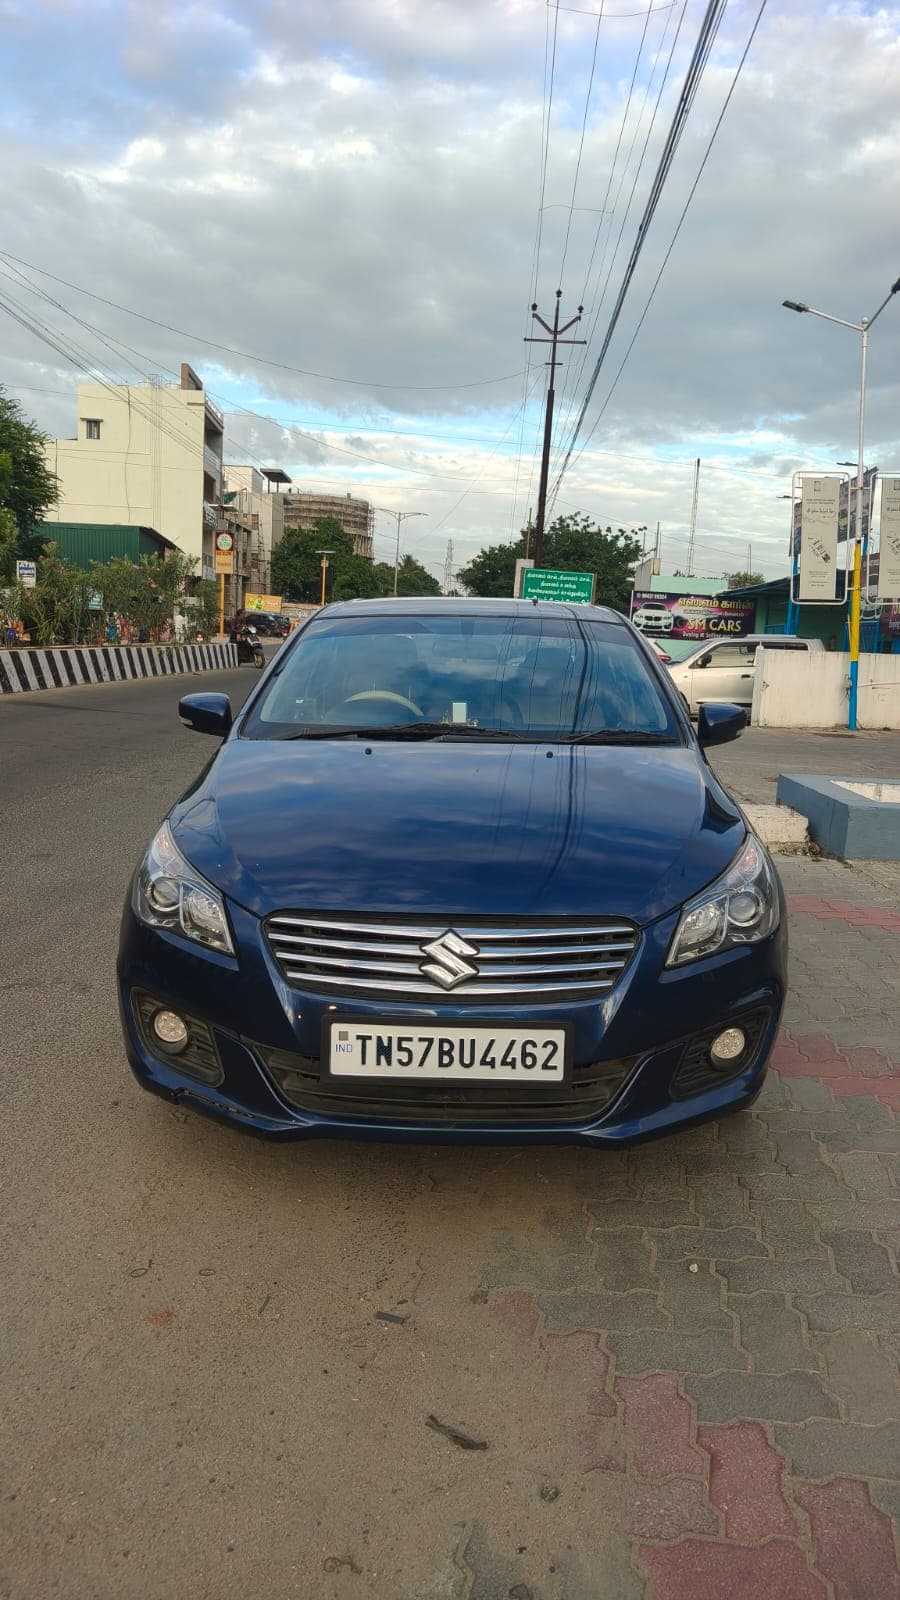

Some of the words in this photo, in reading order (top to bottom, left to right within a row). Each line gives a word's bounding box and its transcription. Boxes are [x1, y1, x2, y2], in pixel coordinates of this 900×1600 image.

[688, 618, 706, 630] SM
[709, 619, 742, 632] CARS
[335, 1043, 353, 1053] IND
[355, 1034, 559, 1071] TN57BU4462
